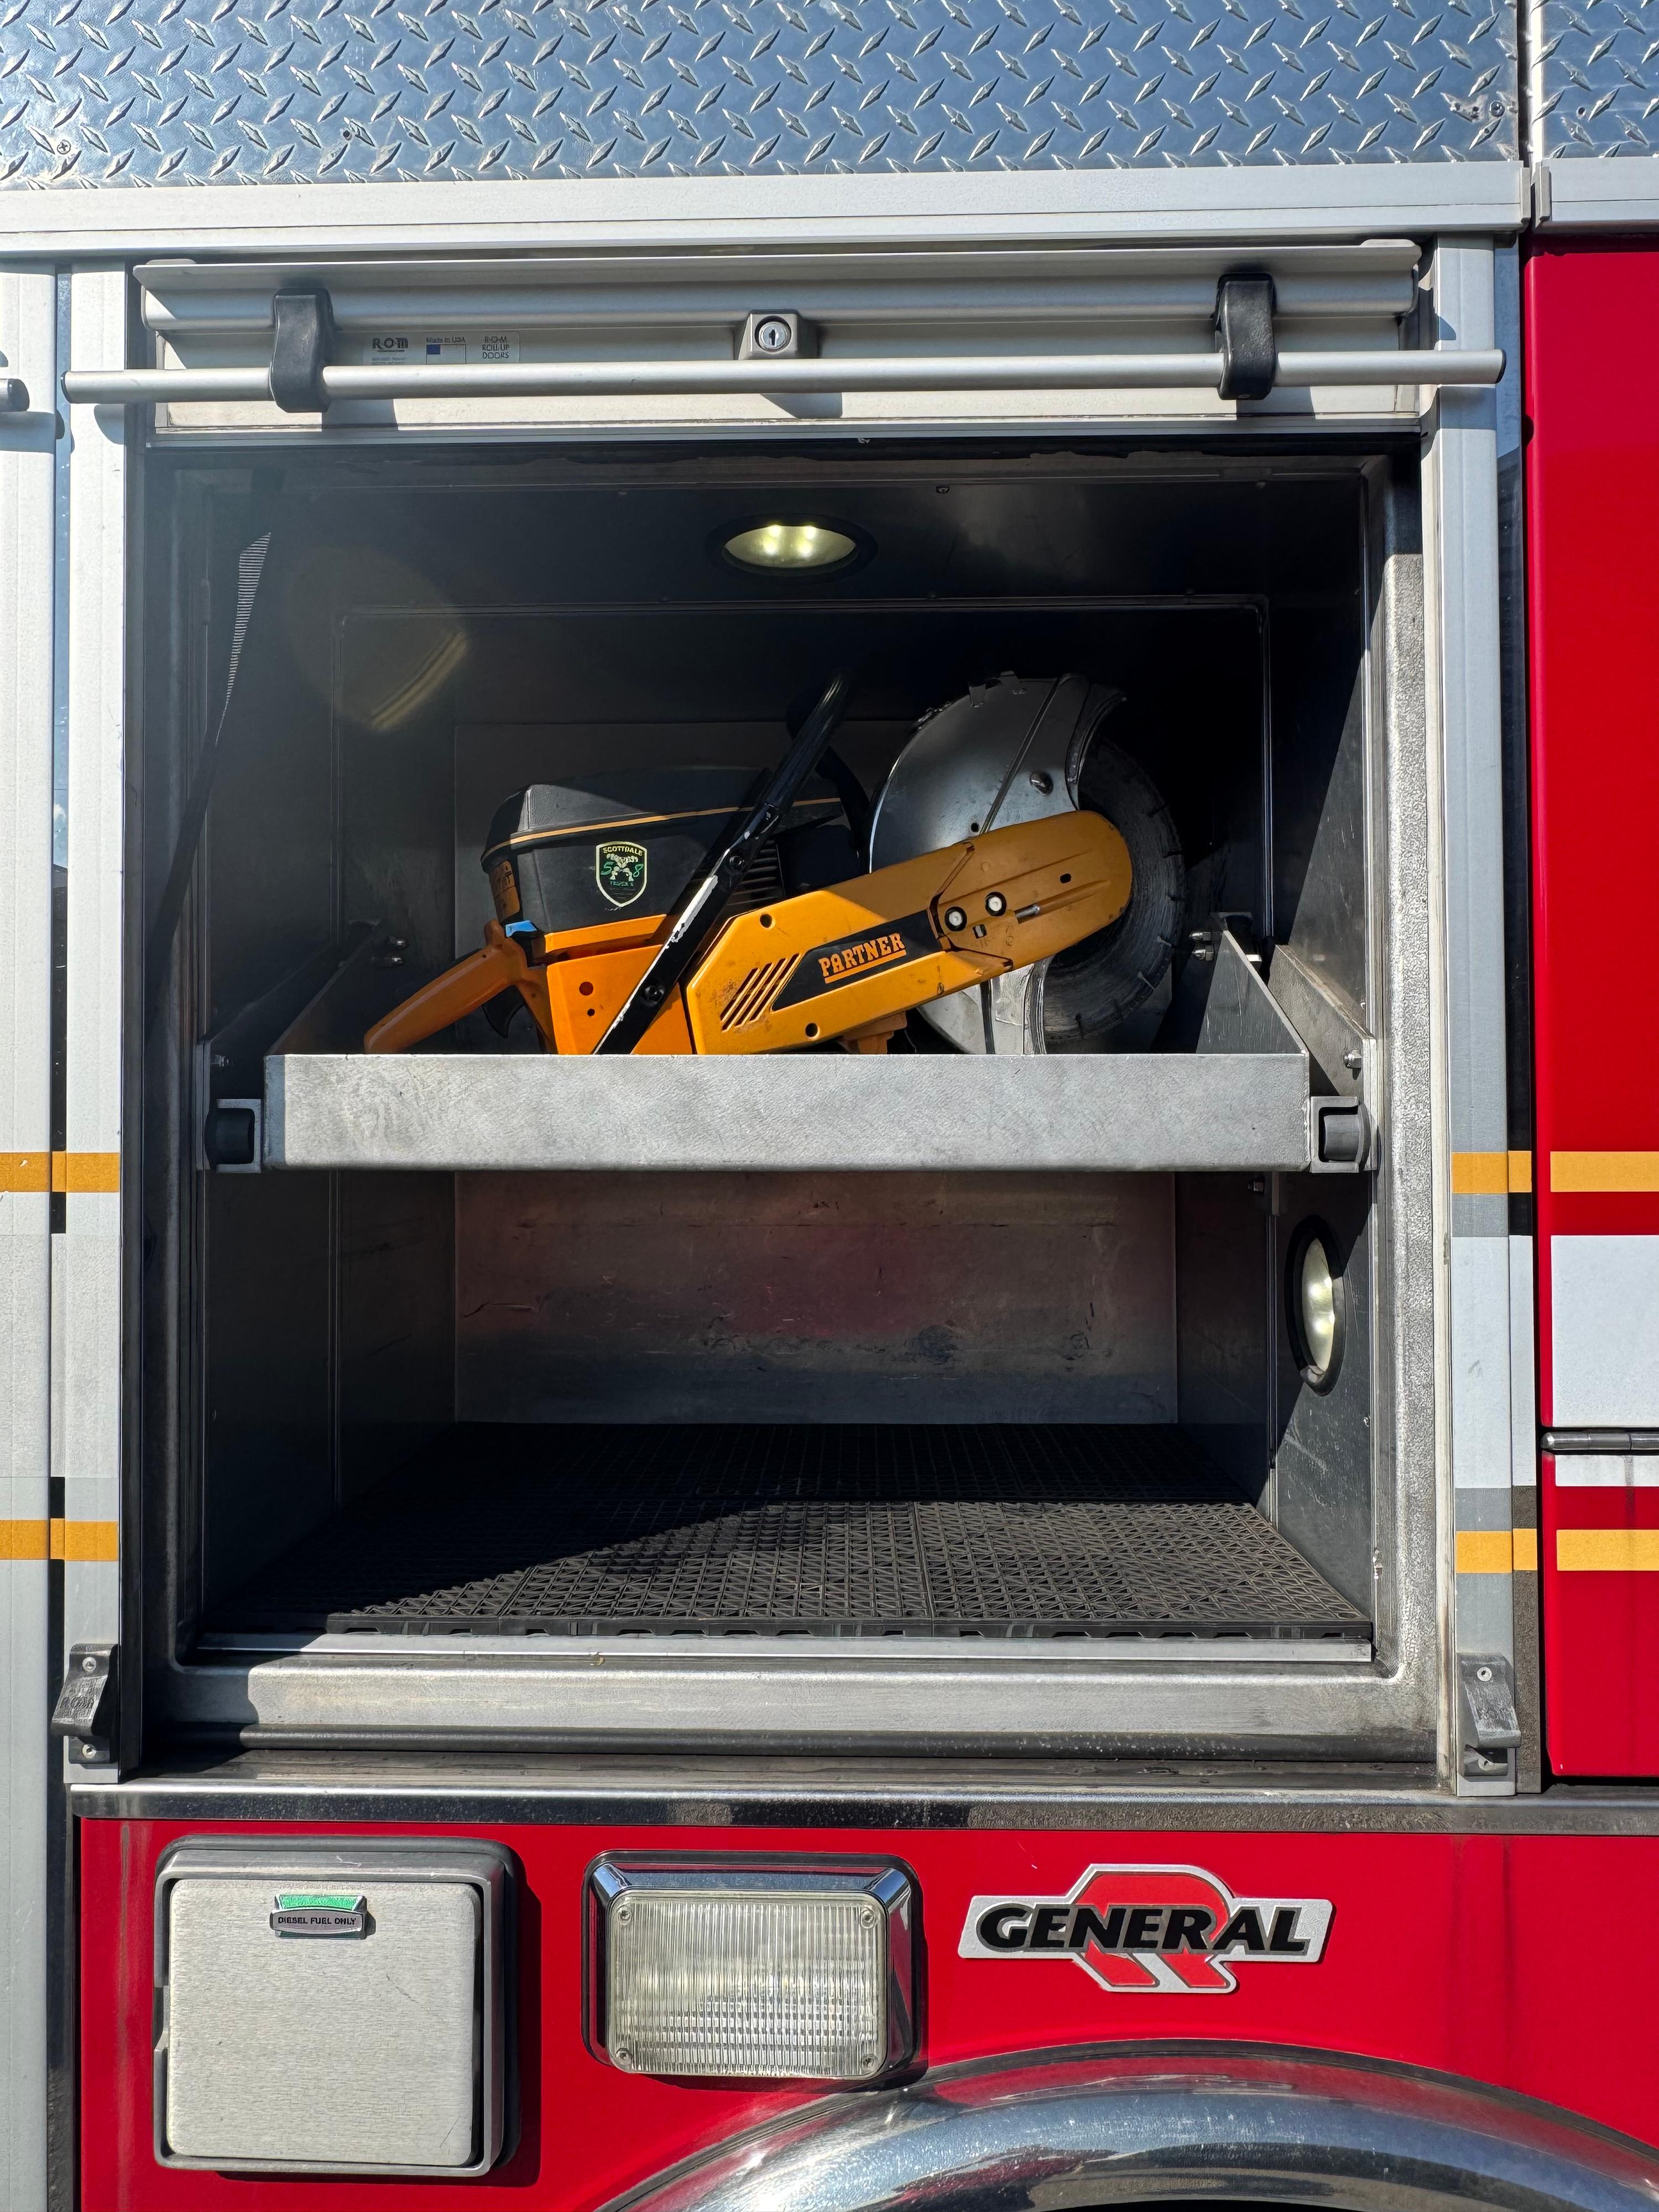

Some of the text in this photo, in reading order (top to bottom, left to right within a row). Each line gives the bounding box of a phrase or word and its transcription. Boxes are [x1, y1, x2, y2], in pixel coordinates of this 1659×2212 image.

[603, 846, 643, 856] SCOTTDALE
[818, 932, 906, 977] PARTNER
[278, 1916, 357, 1926] DIESEL FUEL ONLY
[977, 1904, 1308, 1953] GENERAL
